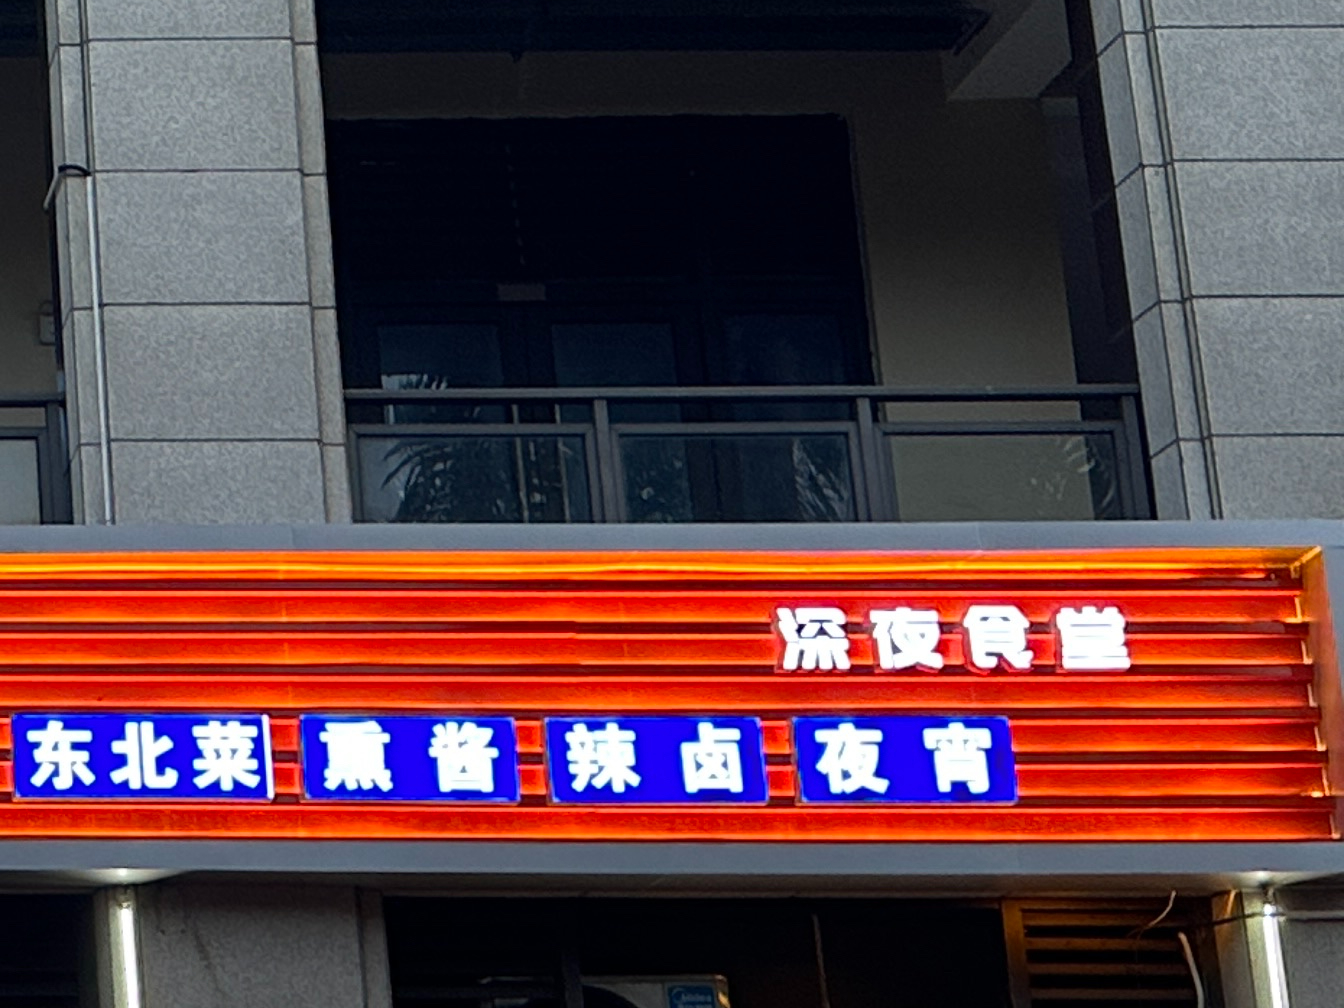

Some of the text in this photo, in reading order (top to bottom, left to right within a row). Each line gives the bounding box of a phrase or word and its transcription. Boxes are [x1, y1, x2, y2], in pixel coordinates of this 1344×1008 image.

[775, 603, 1133, 672] 深夜食堂
[26, 719, 262, 792] 东北菜
[318, 719, 500, 794] 熏酱
[564, 721, 745, 794] 辣卤
[813, 721, 993, 795] 夜宵
